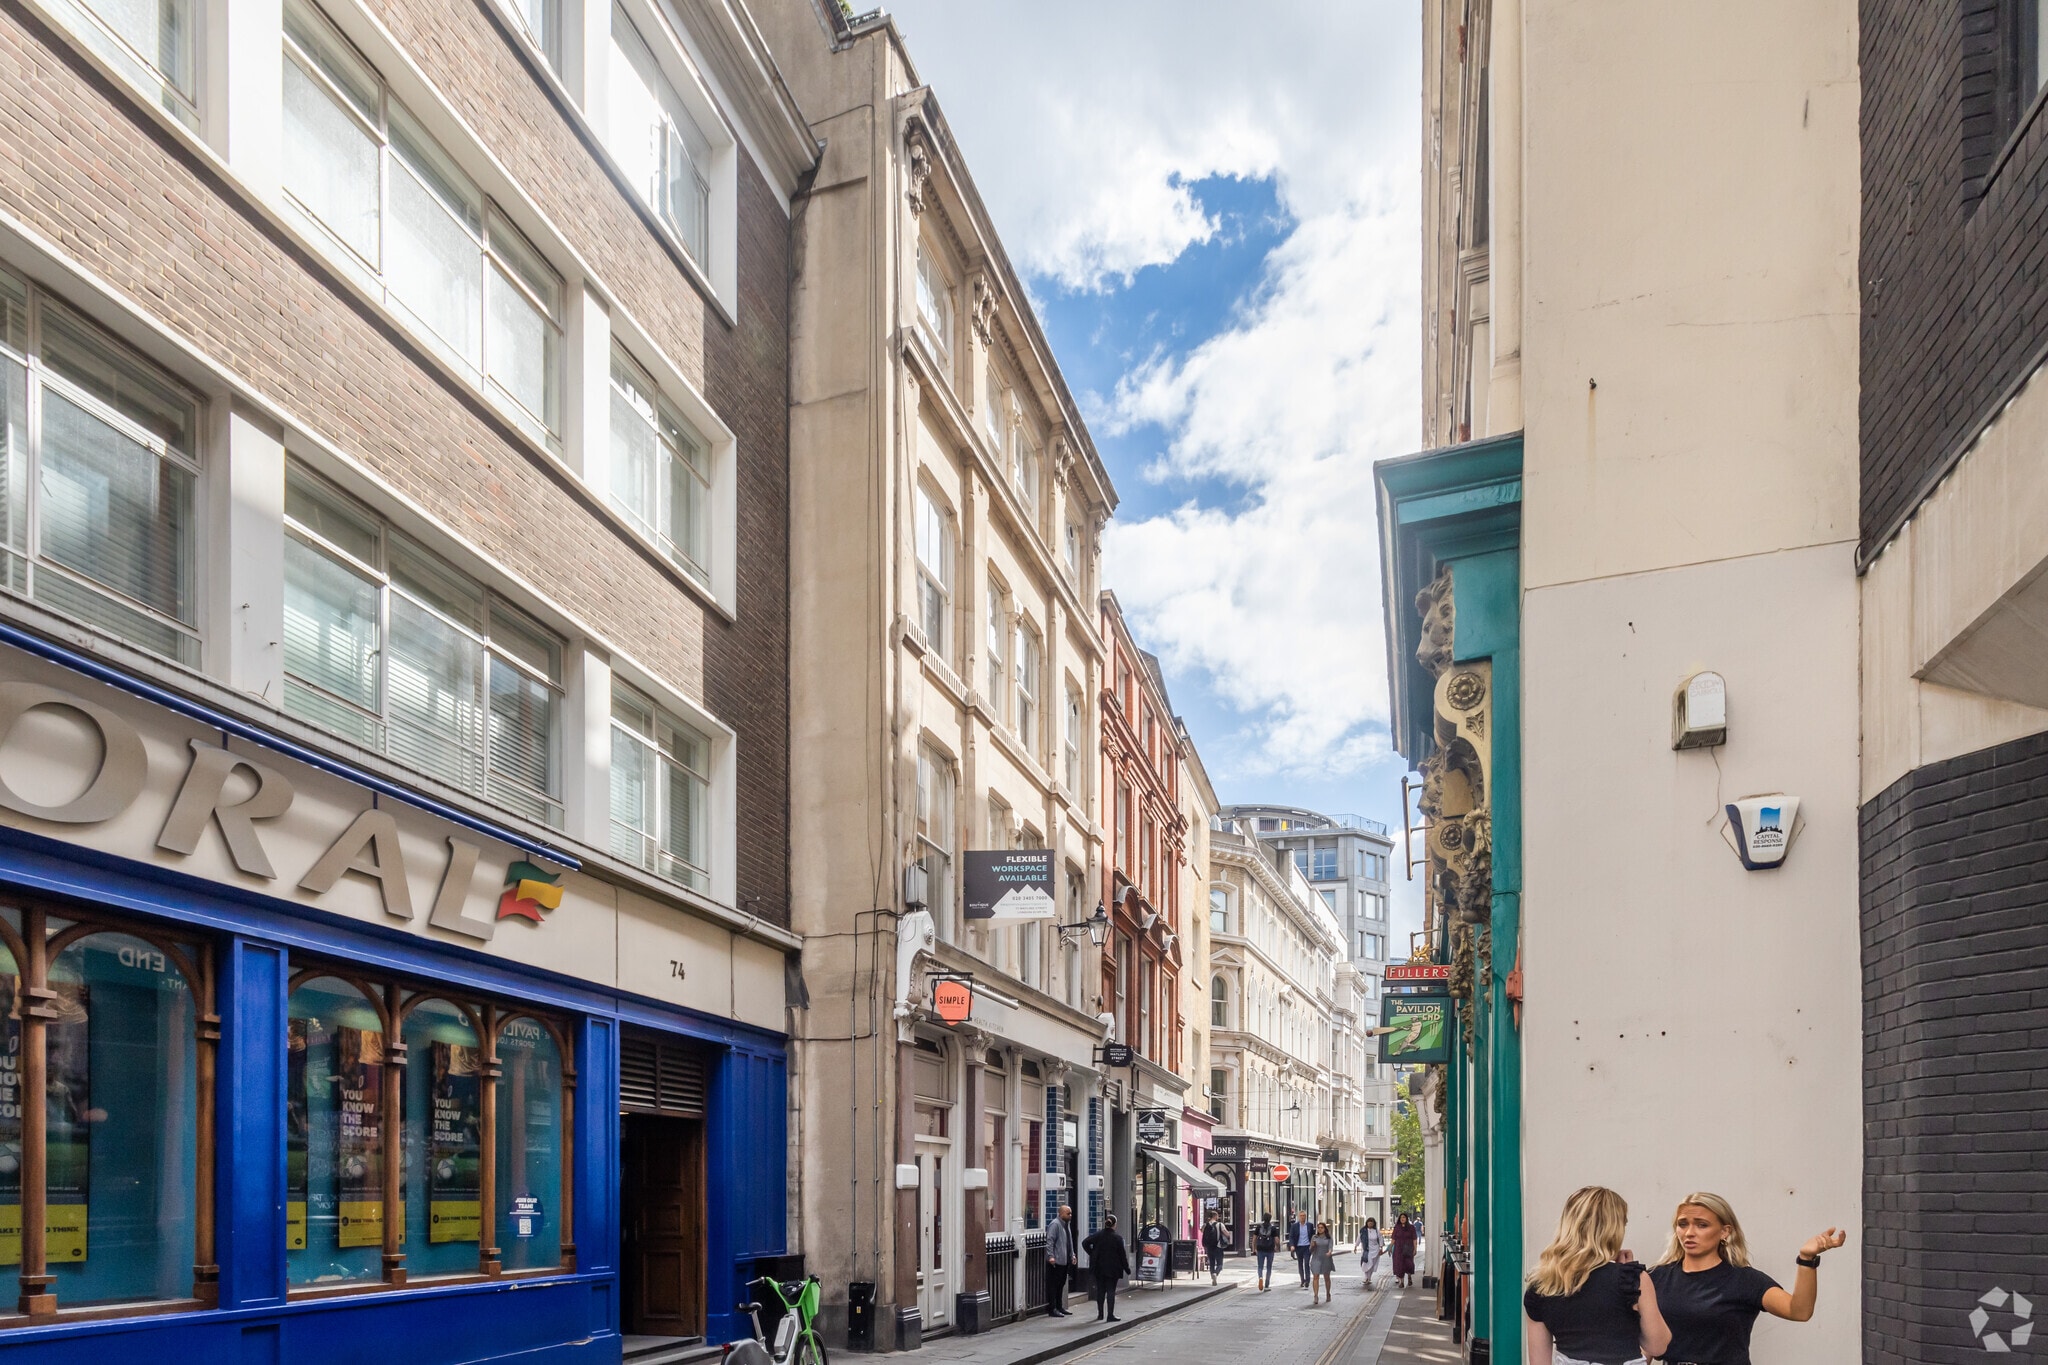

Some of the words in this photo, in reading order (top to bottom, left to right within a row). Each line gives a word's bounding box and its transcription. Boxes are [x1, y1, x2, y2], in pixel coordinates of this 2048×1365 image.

[670, 960, 686, 980] 74
[1389, 966, 1449, 978] FULLER'S
[939, 996, 965, 1004] SIMPLE
[1396, 1005, 1440, 1013] PAVILION
[342, 1089, 363, 1100] YOU
[342, 1101, 374, 1114] KNOW
[435, 1098, 451, 1109] YOU
[342, 1113, 362, 1124] THE
[434, 1109, 461, 1120] KNOW
[434, 1120, 450, 1130] THE
[343, 1126, 378, 1137] SCORE
[434, 1131, 463, 1142] SCORE
[1211, 1145, 1237, 1156] JONES
